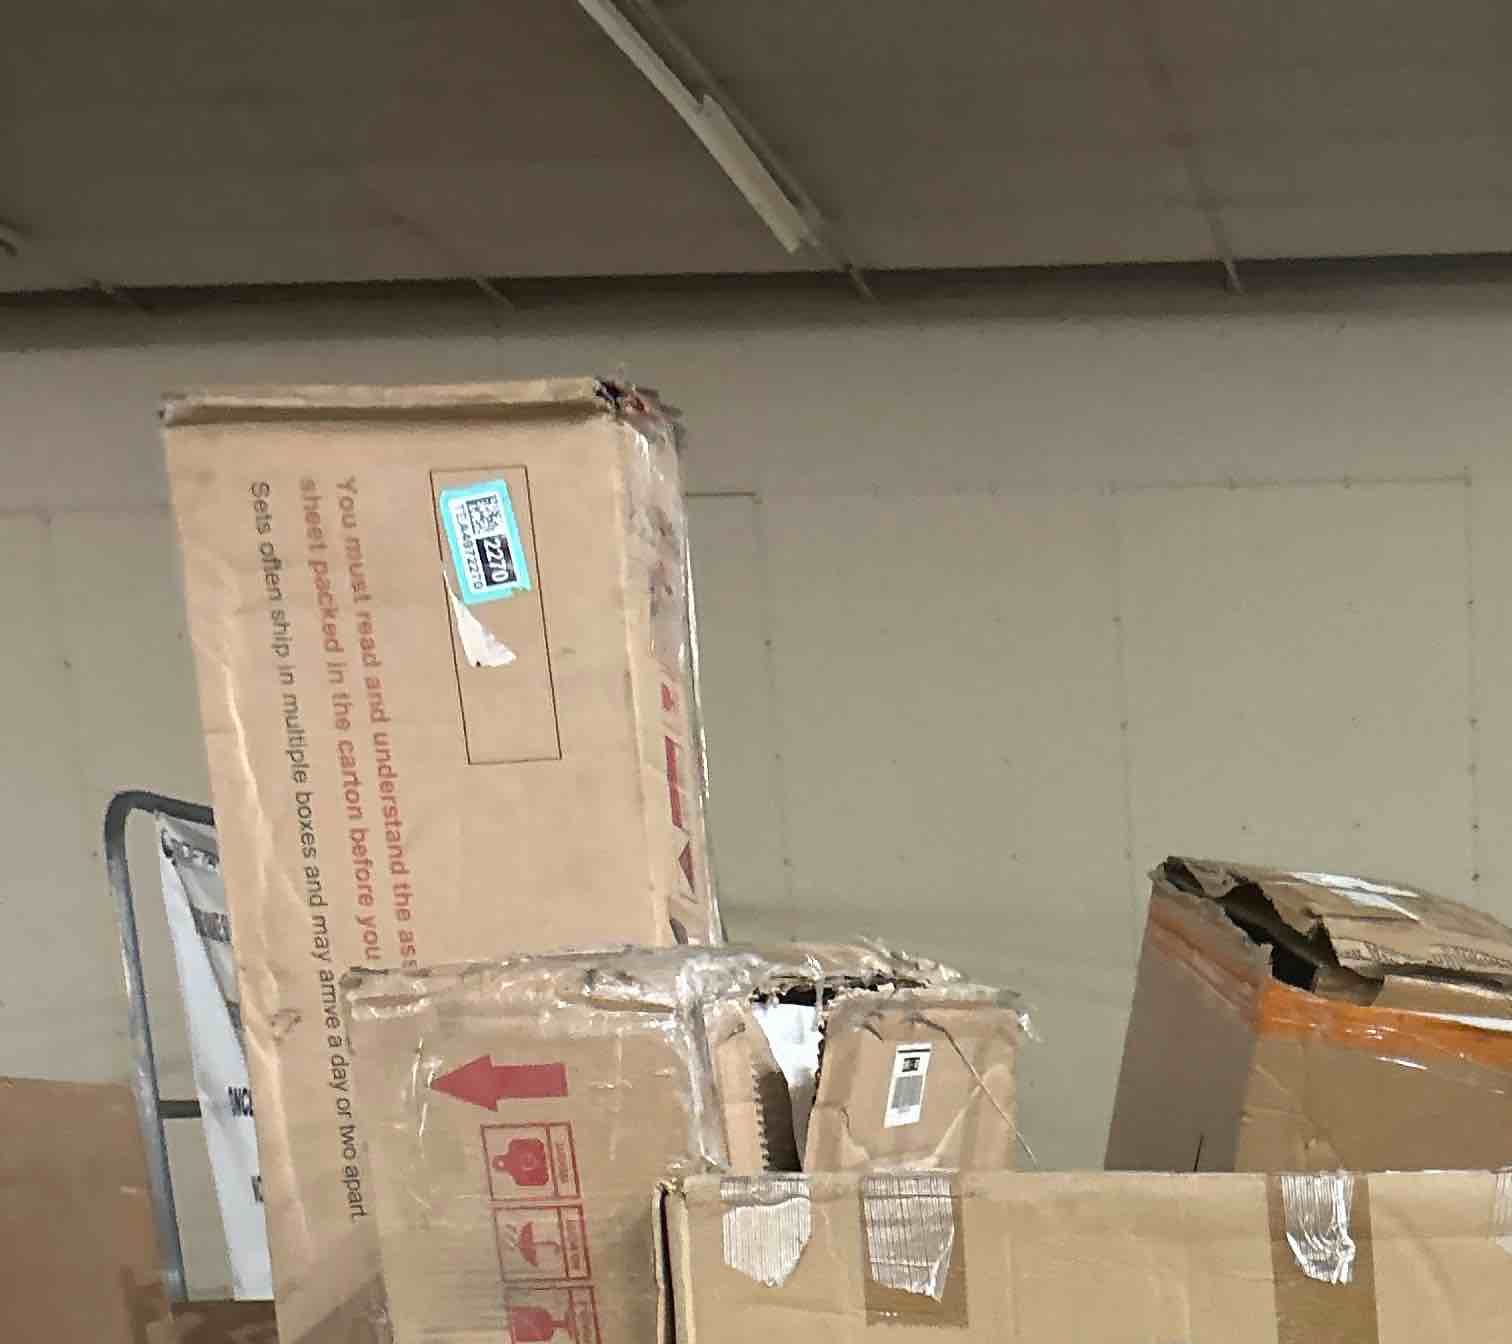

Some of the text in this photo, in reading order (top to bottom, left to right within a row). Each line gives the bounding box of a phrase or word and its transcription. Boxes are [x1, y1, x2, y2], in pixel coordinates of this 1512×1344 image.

[250, 481, 273, 535] Sets
[336, 476, 358, 529] You
[259, 541, 283, 602] often
[345, 536, 372, 604] must
[484, 538, 510, 583] 2270
[271, 609, 293, 658] ship
[357, 610, 382, 668] read
[278, 665, 297, 686] in
[366, 676, 391, 724] and
[283, 693, 310, 784] multiple
[301, 478, 382, 960] sheet packed in the carton before you
[296, 792, 317, 859] boxes
[373, 731, 410, 875] understand
[304, 866, 329, 907] and
[392, 881, 414, 921] the
[312, 914, 332, 963] may
[320, 969, 343, 1029] arrive
[328, 1036, 342, 1048] a
[329, 1055, 350, 1092] day
[336, 1097, 353, 1118] or
[339, 1125, 357, 1160] two
